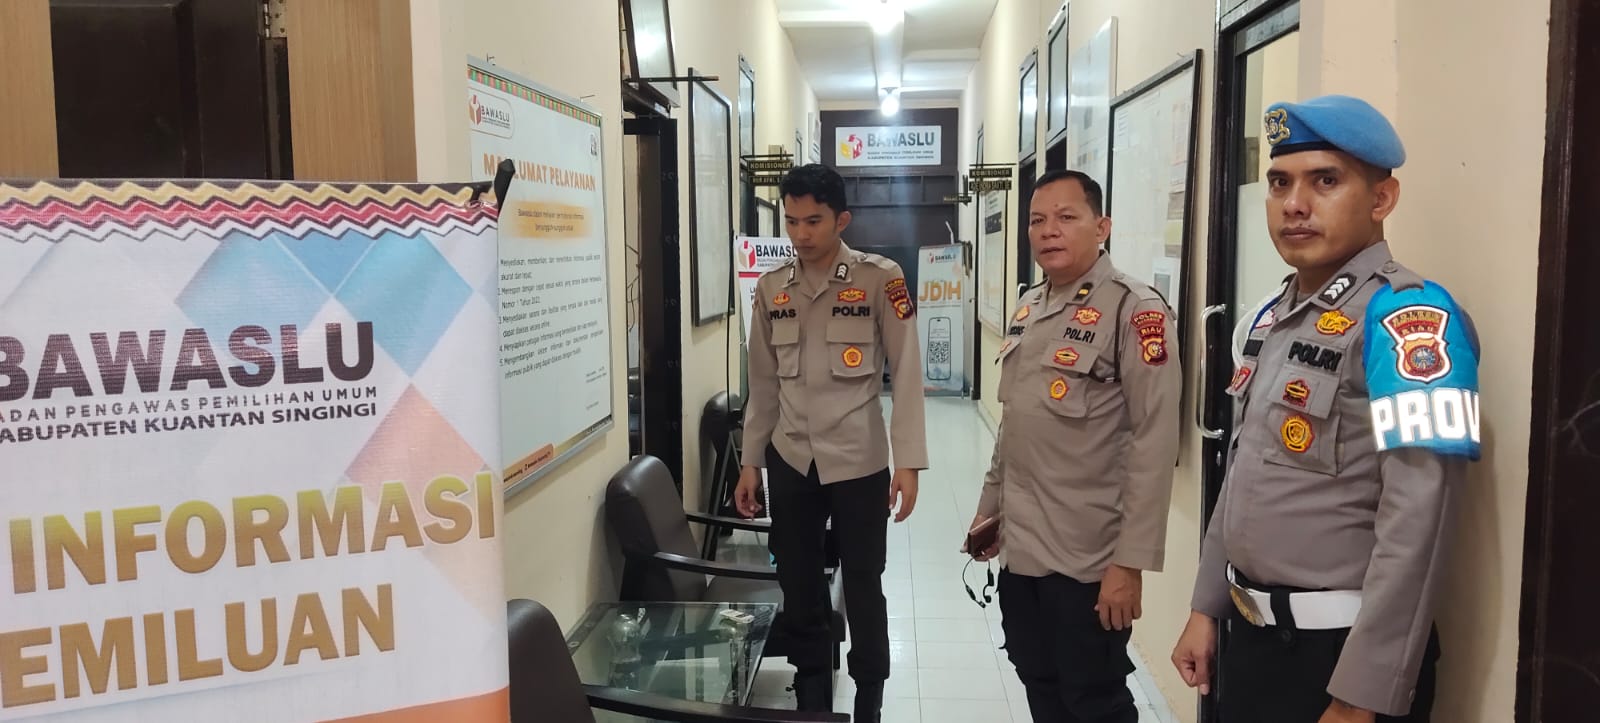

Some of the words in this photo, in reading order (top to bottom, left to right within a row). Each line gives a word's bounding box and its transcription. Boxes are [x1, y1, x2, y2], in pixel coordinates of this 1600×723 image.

[481, 105, 510, 122] BAWASLU
[867, 132, 934, 147] BAWASLU
[549, 166, 596, 191] PELAYANAN
[918, 281, 962, 301] JDIH
[832, 306, 870, 317] POLRI
[1063, 327, 1096, 344] POLRI
[1141, 327, 1162, 335] RIAU
[0, 321, 374, 401] BAWASLU
[1288, 341, 1342, 372] POLRI
[66, 398, 190, 418] PENGAWAS
[199, 391, 314, 409] PEMILIHAN
[323, 386, 377, 401] UMUM
[0, 420, 137, 444] ABUPATEN
[145, 411, 264, 433] KUANTAN
[272, 403, 376, 423] SINGINGI
[9, 472, 495, 594] INFORMASI
[0, 583, 395, 708] EMILUAN
